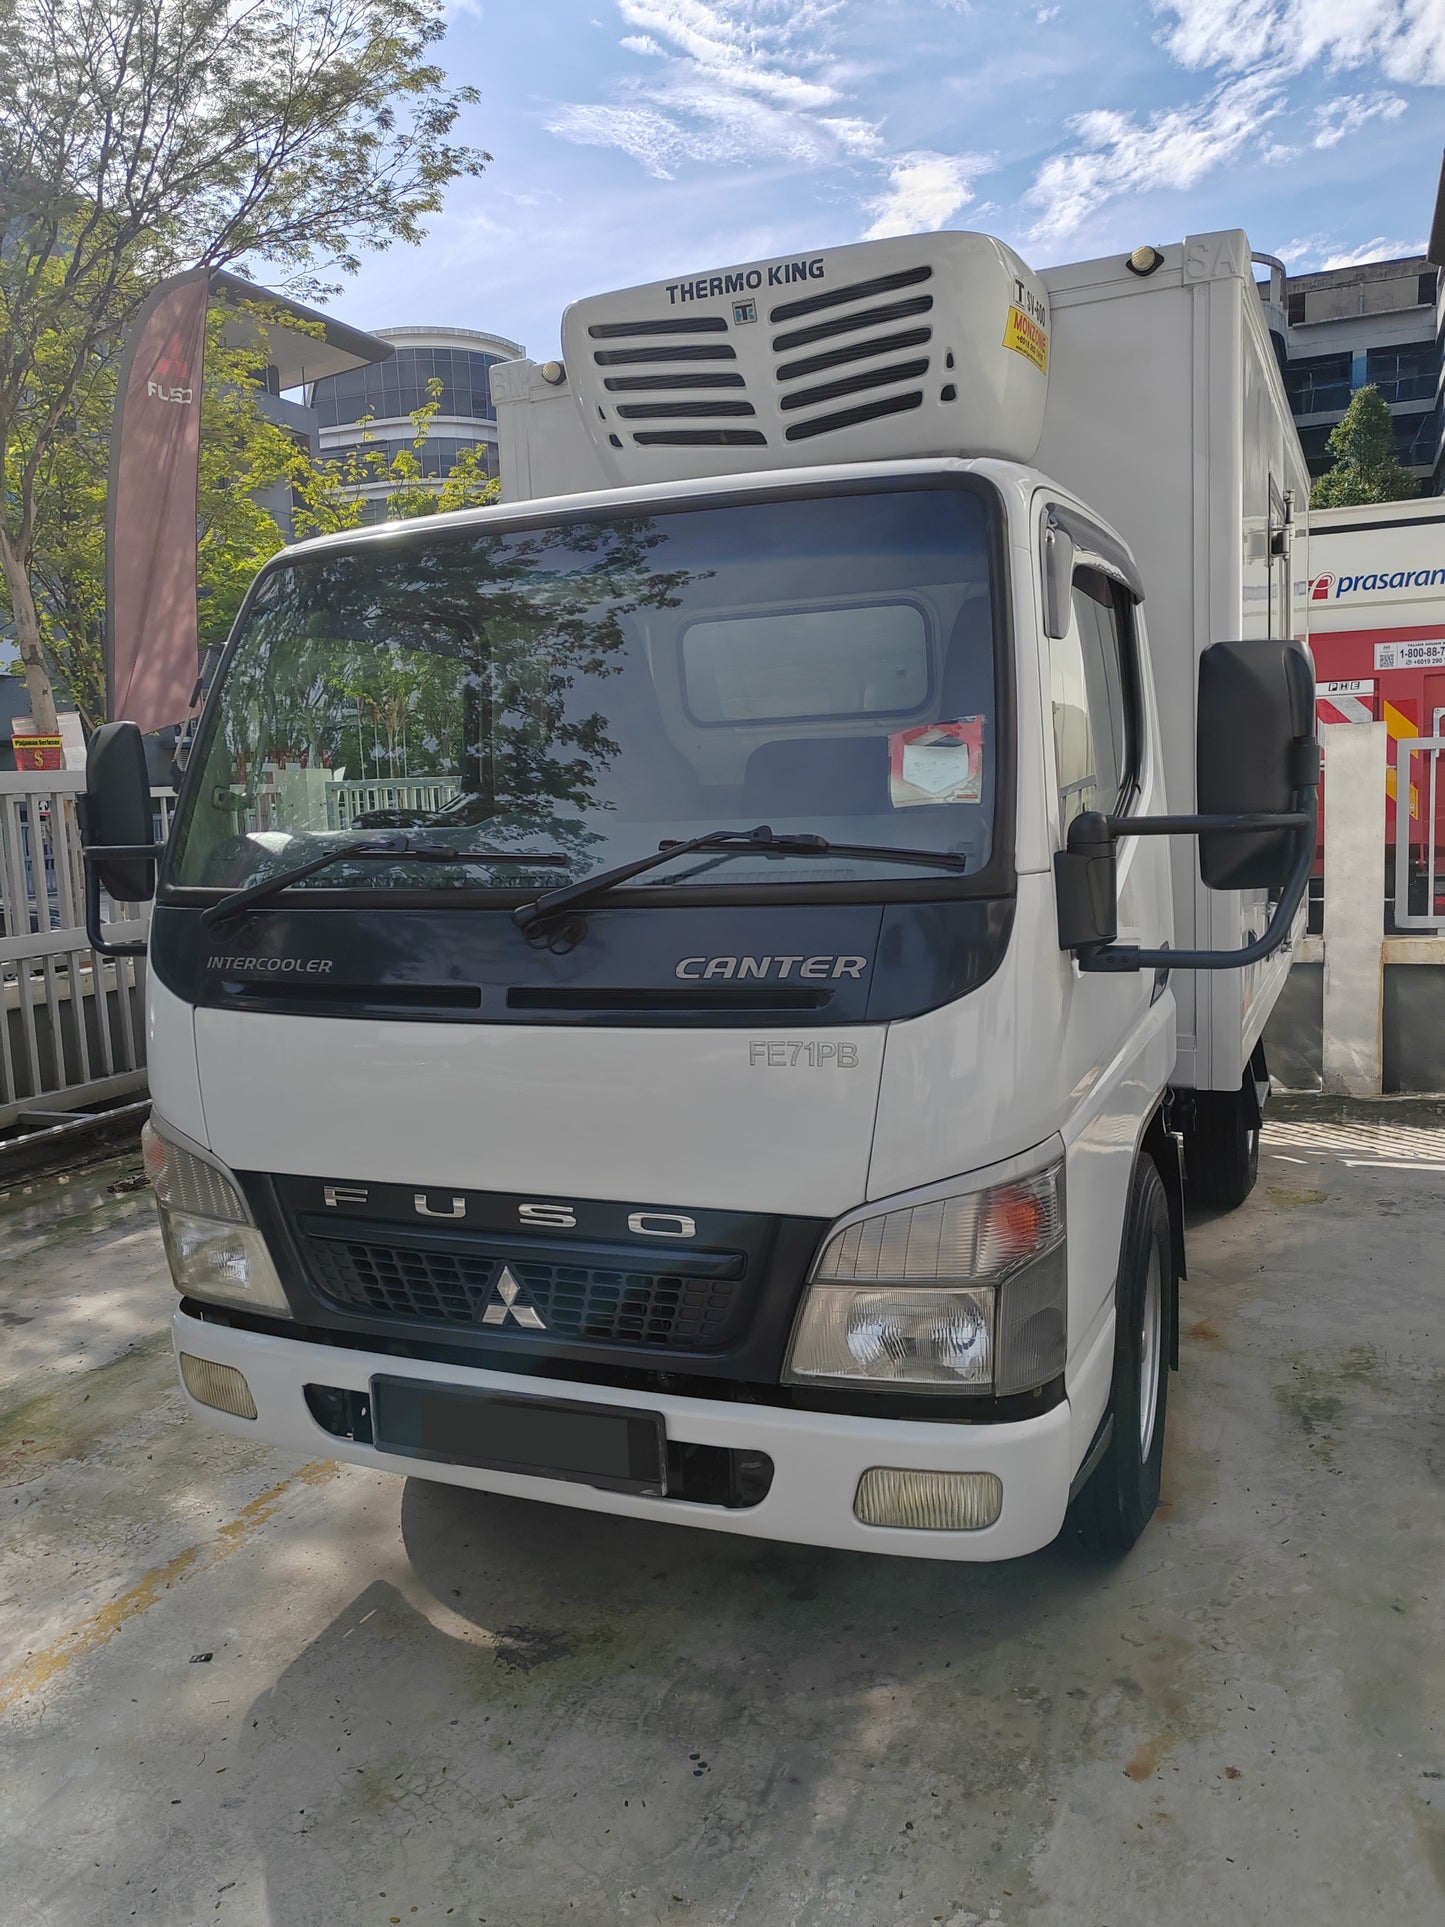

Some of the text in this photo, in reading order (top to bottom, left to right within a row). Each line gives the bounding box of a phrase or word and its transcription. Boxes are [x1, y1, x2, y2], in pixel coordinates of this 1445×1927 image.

[665, 258, 825, 305] THERMO KING
[207, 956, 333, 973] INTERCOOLER
[674, 955, 868, 980] CANTER
[749, 1040, 859, 1069] FE71PB
[323, 1185, 697, 1239] FUSO
